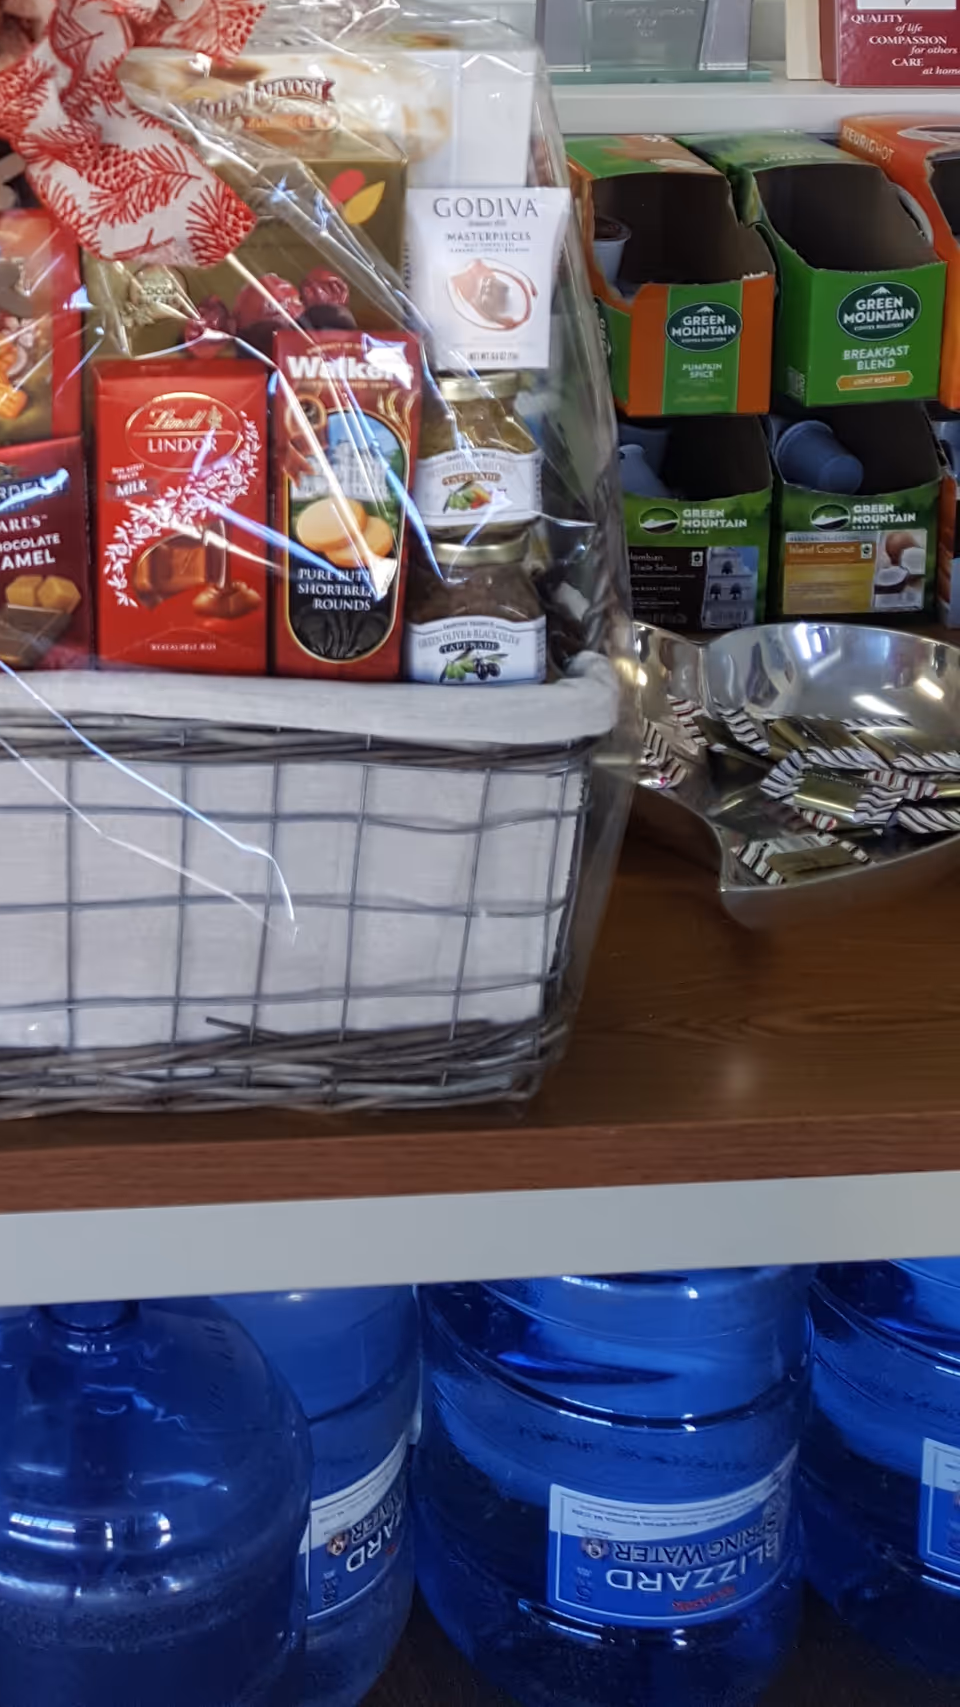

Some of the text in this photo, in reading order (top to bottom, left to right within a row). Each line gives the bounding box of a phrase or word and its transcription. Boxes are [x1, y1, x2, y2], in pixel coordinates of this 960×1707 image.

[851, 14, 903, 24] QUALITY
[896, 23, 923, 34] of life
[869, 36, 948, 45] COMPASSION
[910, 46, 958, 56] for others
[891, 58, 924, 66] CARE
[922, 67, 934, 75] at
[433, 197, 539, 218] GODIVA
[447, 232, 531, 242] MASTERPIECES
[856, 296, 904, 311] GREEN
[682, 315, 726, 326] GREEN
[843, 308, 915, 324] MOUNTAIN
[671, 325, 736, 337] MOUNTAIN
[842, 345, 910, 360] BREAKFAST
[682, 363, 722, 371] PUMPKIN
[857, 358, 896, 370] BLEND
[148, 437, 218, 453] LINDOR
[116, 479, 148, 497] MILK
[682, 509, 724, 517] GREEN
[853, 503, 894, 513] GREEN
[682, 519, 747, 528] MOUNTAIN
[852, 513, 916, 523] MOUNTAIN
[790, 545, 856, 554] Island Coconut
[313, 598, 371, 611] ROUNDS
[612, 1542, 704, 1566] WATER
[707, 1510, 778, 1559] SPRING
[605, 1531, 780, 1591] BLIZZARD
